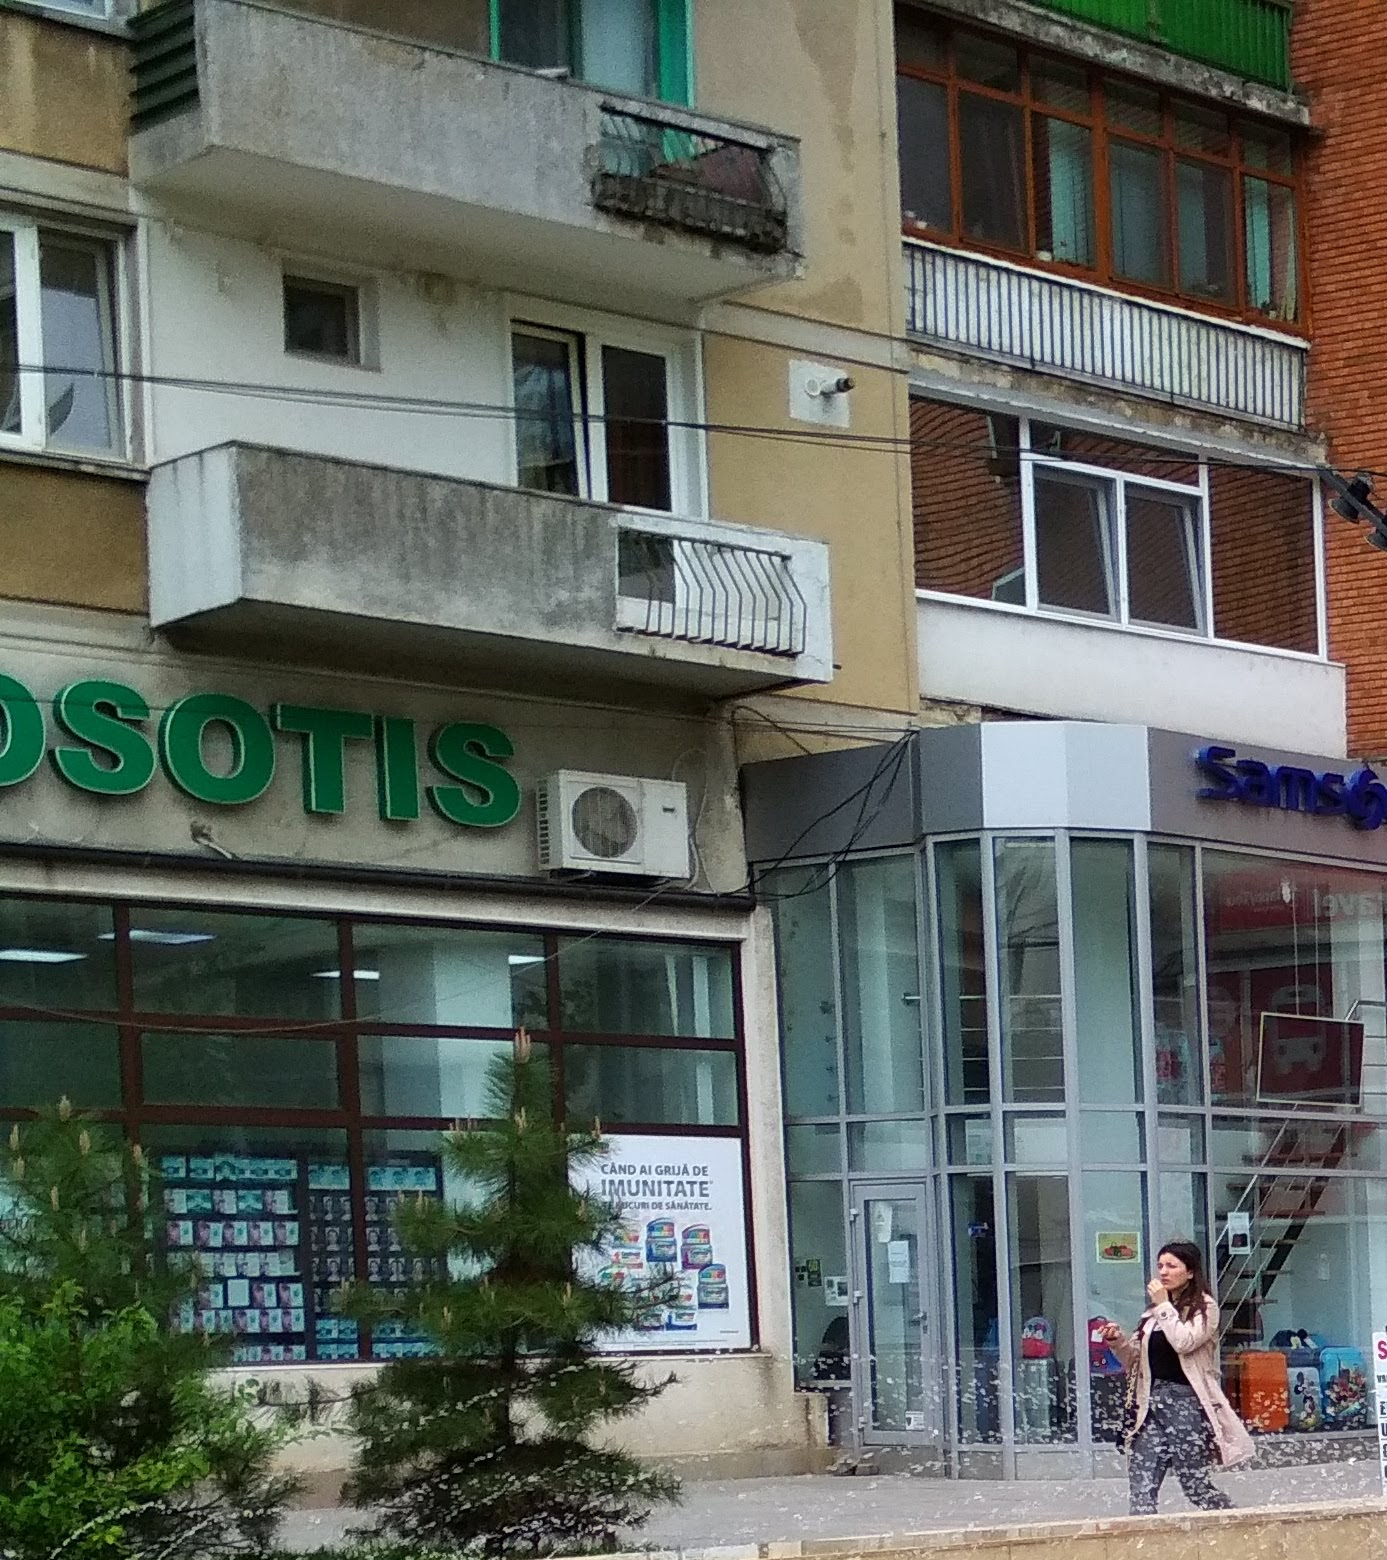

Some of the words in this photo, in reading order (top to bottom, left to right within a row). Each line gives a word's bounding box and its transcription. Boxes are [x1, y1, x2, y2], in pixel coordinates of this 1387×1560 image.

[600, 1162, 636, 1176] CÂND
[639, 1164, 652, 1176] AI
[655, 1163, 690, 1177] GRIJĂ
[692, 1165, 709, 1177] DE
[600, 1178, 710, 1198] IMUNITATE
[651, 1201, 664, 1211] DE
